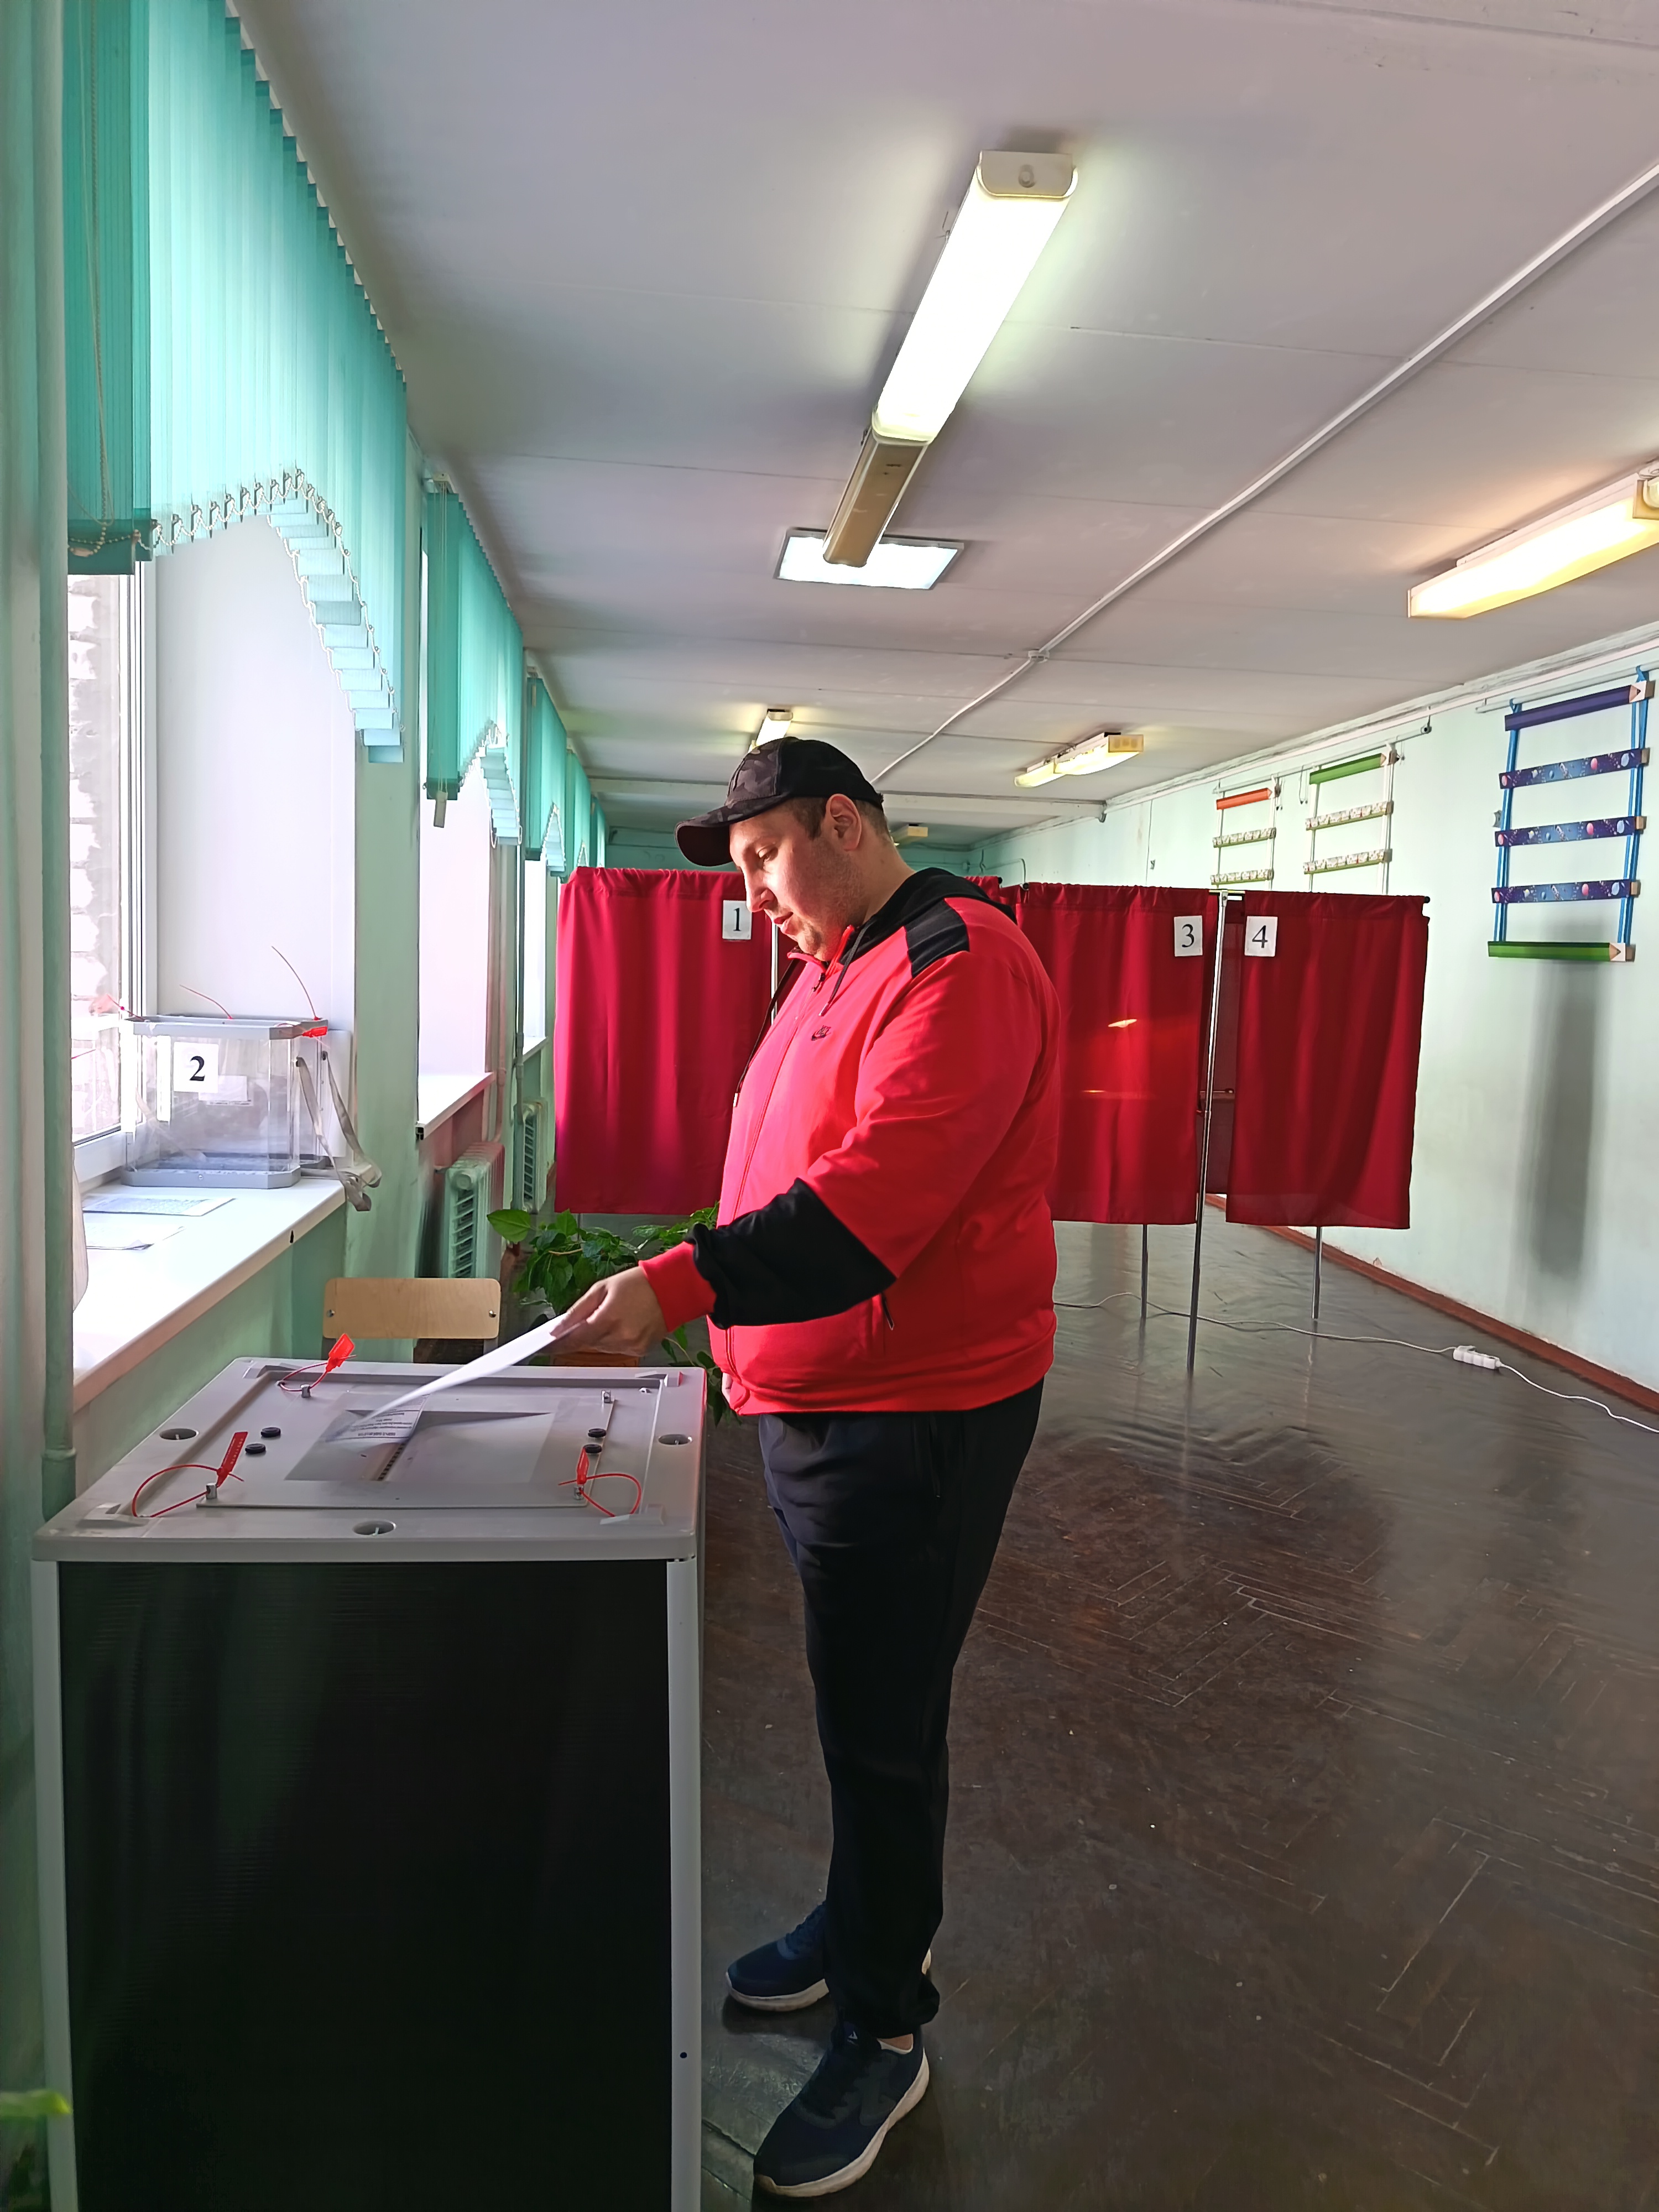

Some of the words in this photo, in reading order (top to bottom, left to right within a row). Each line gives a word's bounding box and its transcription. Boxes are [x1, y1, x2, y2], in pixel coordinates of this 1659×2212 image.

[733, 907, 742, 932] 1
[1181, 924, 1194, 948] 3
[1251, 925, 1268, 948] 4
[189, 1056, 205, 1082] 2
